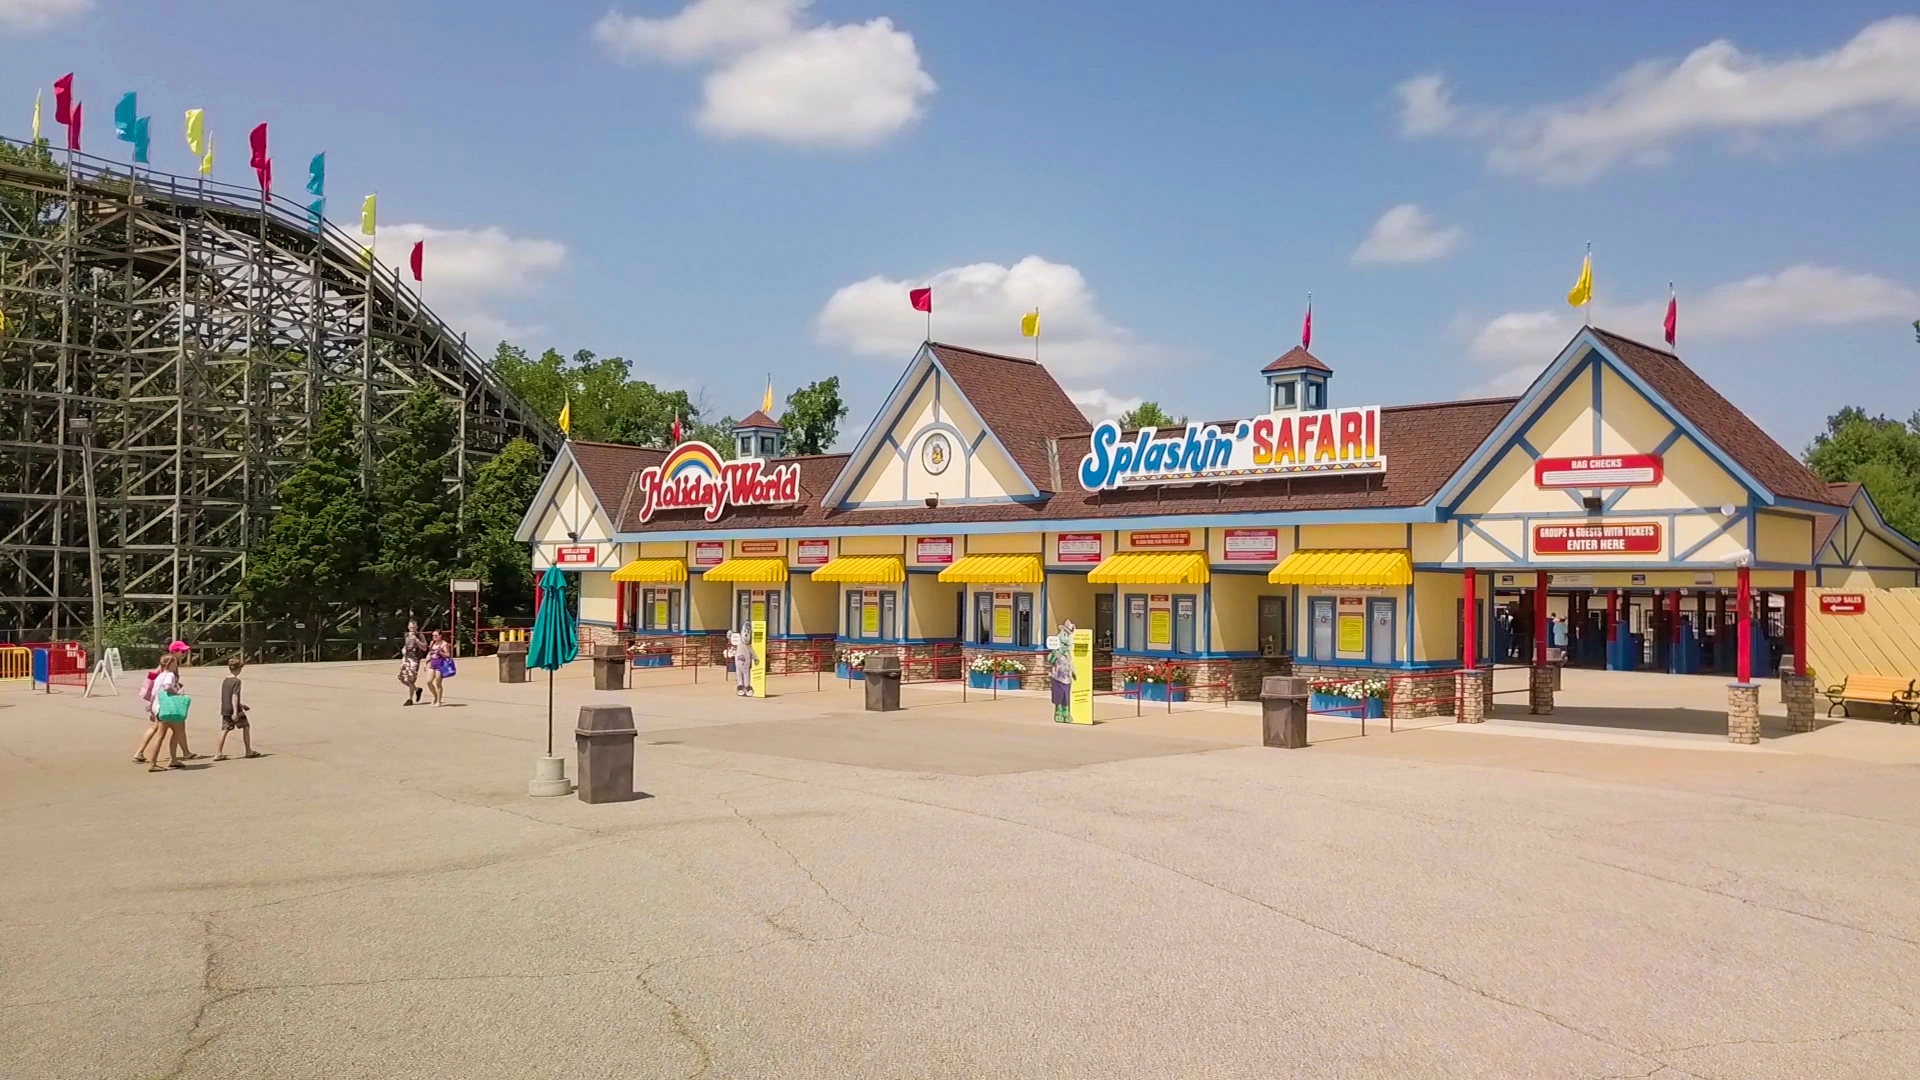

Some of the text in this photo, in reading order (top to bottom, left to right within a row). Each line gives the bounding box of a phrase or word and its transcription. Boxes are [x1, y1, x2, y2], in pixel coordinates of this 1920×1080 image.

[1082, 409, 1375, 487] Splashin' SAFARI
[1571, 459, 1622, 469] BAG CHECKS
[641, 462, 796, 520] Holiday World
[1540, 526, 1654, 538] GROUPS & GUESTS WITH TICKETS
[1567, 539, 1625, 551] ENTER HERE
[1822, 596, 1862, 604] GROUP SALES
